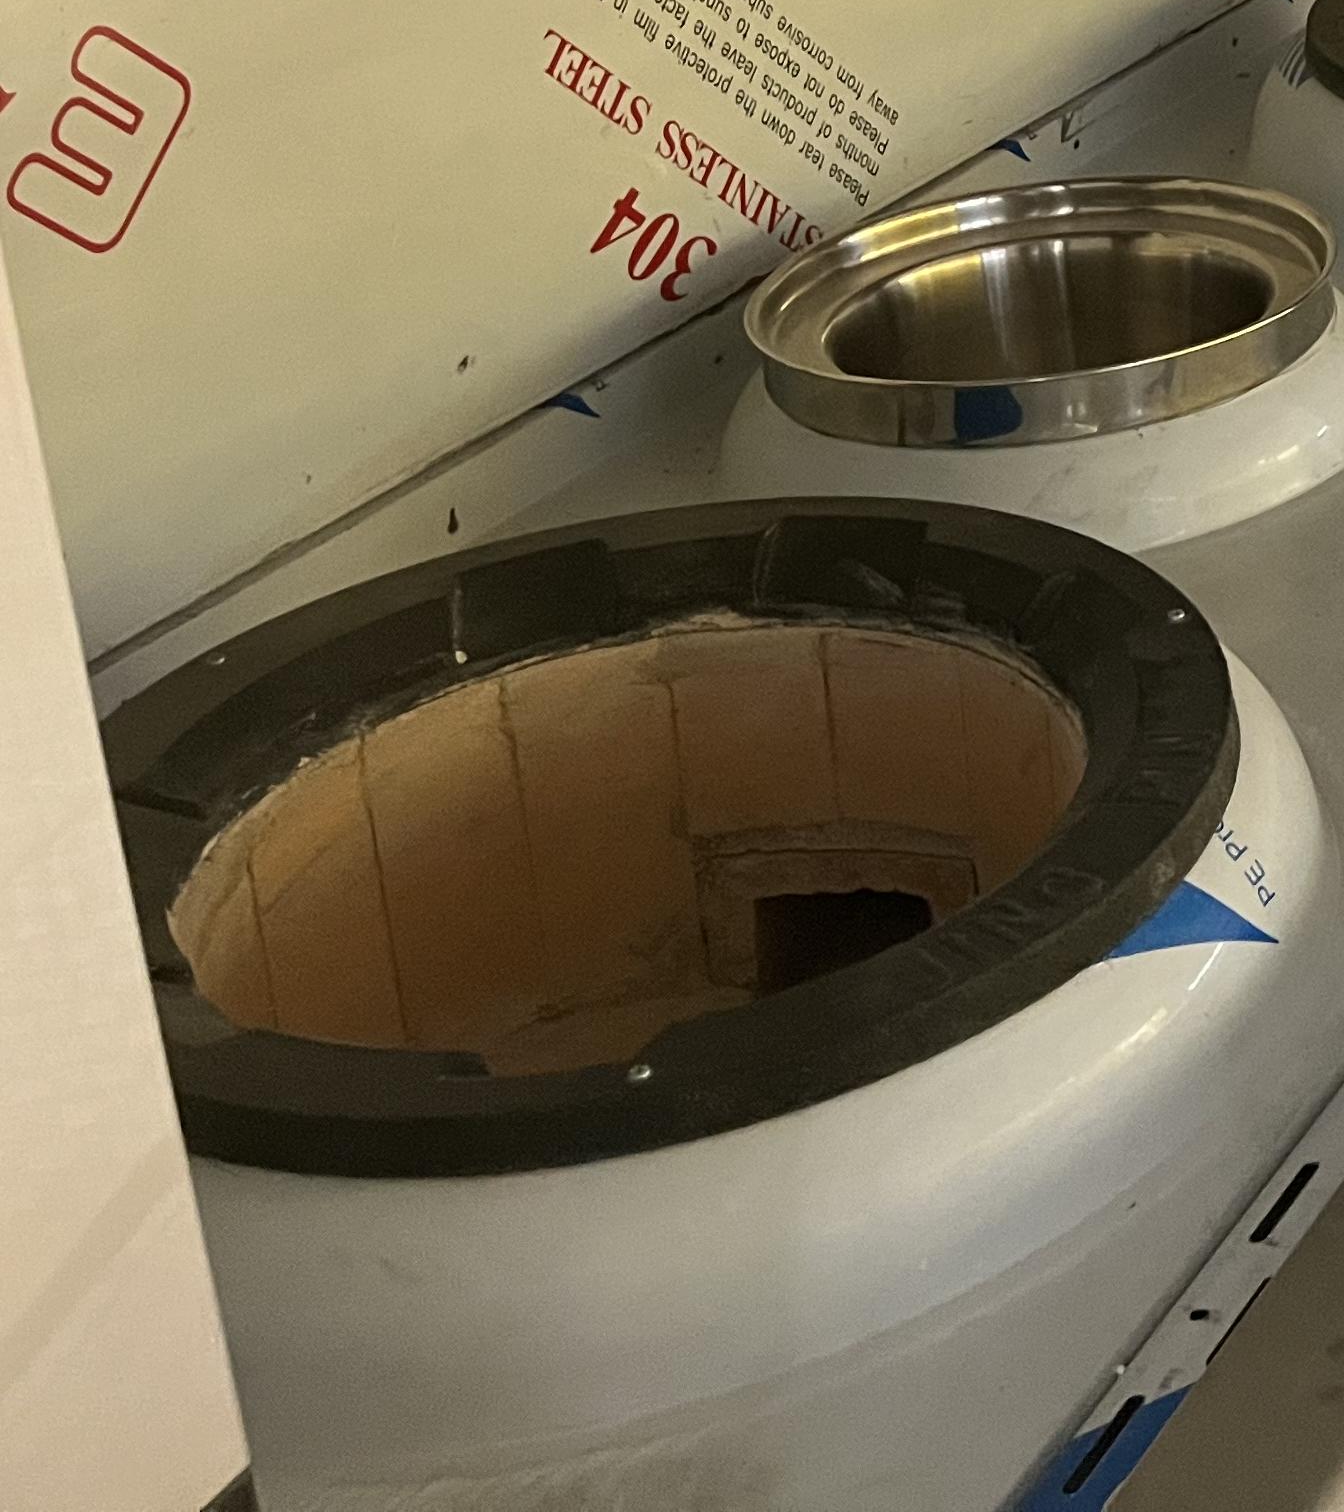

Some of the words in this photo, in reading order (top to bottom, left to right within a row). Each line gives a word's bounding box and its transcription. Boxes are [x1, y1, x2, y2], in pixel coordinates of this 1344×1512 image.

[633, 8, 660, 43] film
[693, 19, 717, 50] the
[736, 18, 751, 40] to
[777, 15, 834, 70] corrosive
[664, 34, 734, 94] protective
[720, 41, 758, 84] leave
[754, 33, 801, 78] expose
[543, 28, 653, 135] STEEL
[761, 74, 818, 126] products
[803, 73, 826, 98] not
[836, 65, 865, 100] from
[735, 89, 757, 118] the
[828, 93, 846, 116] do
[867, 89, 899, 126] away
[761, 108, 796, 146] down
[816, 120, 832, 139] of
[849, 110, 890, 156] Please
[798, 140, 825, 171] tear
[835, 134, 880, 177] months
[655, 120, 824, 253] STAINLESS
[828, 163, 870, 207] Please
[590, 187, 718, 302] 304
[1243, 858, 1276, 907] PE
